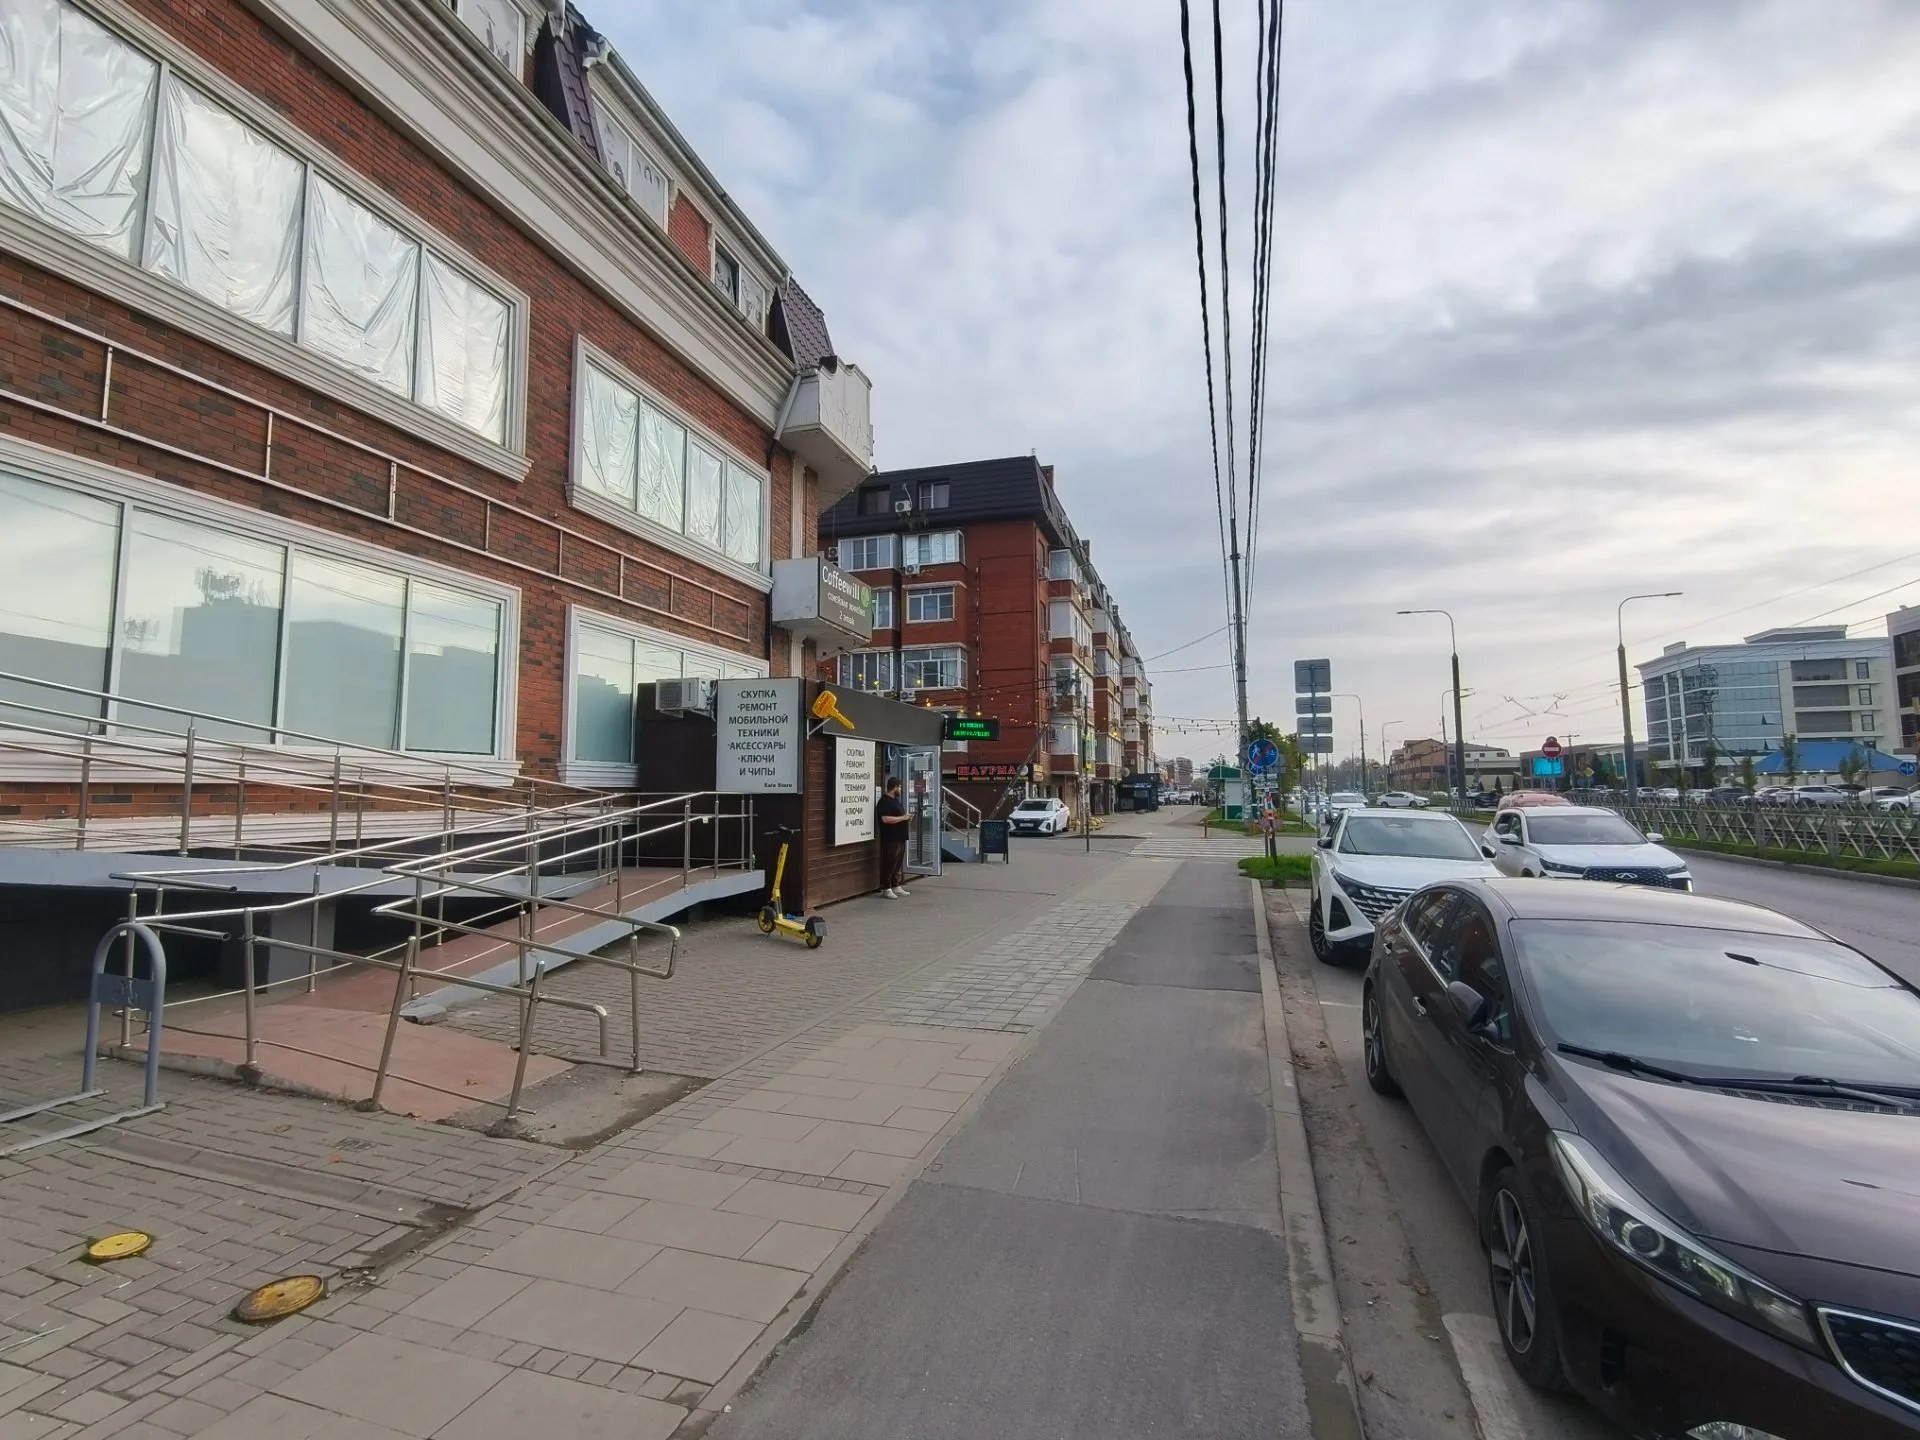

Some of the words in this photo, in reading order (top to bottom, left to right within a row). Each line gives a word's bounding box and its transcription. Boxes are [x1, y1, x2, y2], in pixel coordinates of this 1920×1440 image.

[822, 566, 860, 600] Coffeewill
[740, 689, 777, 698] СКУПКА
[739, 702, 778, 711] РЕМОНТ
[728, 713, 789, 724] МОБИЛЬНОЙ
[737, 728, 780, 737] ТЕХНИКИ
[729, 741, 786, 750] АКСЕССУАРЫ
[740, 754, 775, 763] КЛЮЧИ
[845, 760, 865, 768] РЕМОНТ
[739, 767, 746, 775] И
[748, 767, 776, 775] ЧИПЫ
[957, 766, 1017, 775] ШАУРМА
[840, 771, 871, 780] МОБИЛЬНОЙ
[844, 783, 867, 792] ТЕХНИКИ
[840, 795, 870, 804] АКСЕССУАРЫ
[845, 807, 863, 815] КЛЮЧИ
[850, 818, 864, 826] ЧИПЫ
